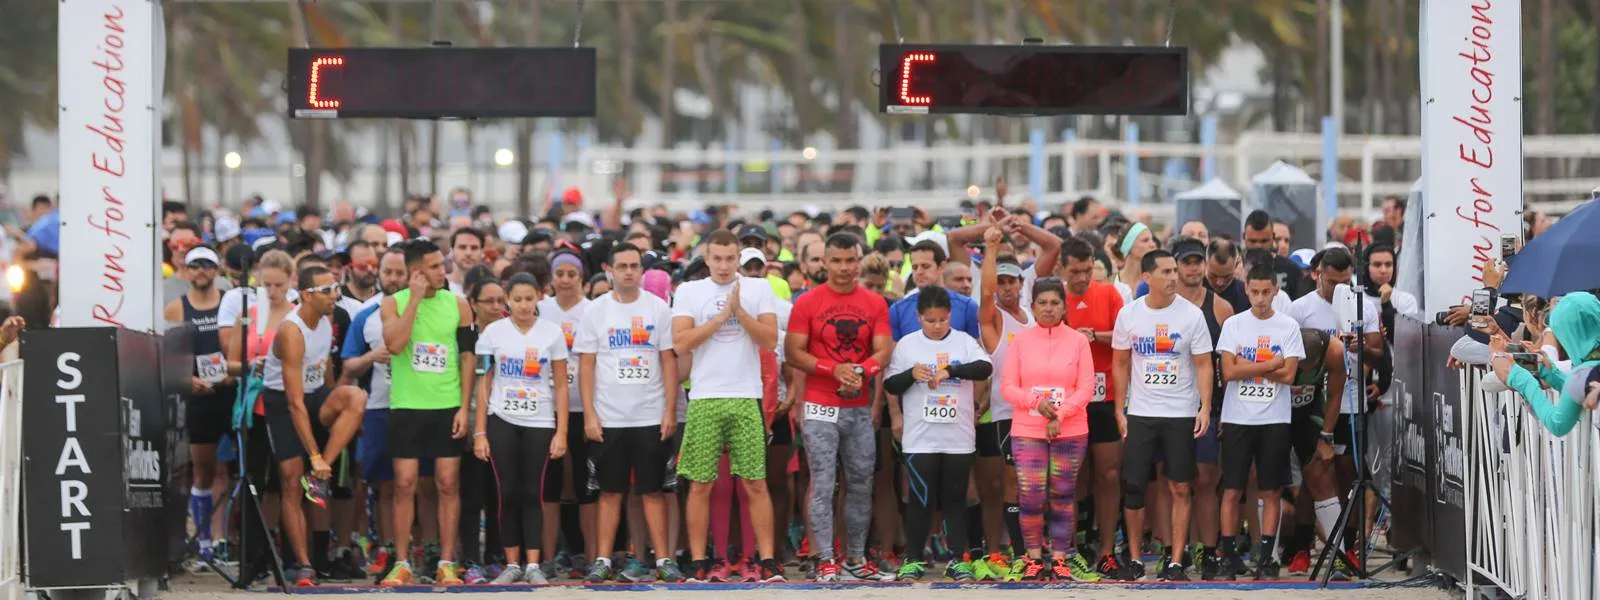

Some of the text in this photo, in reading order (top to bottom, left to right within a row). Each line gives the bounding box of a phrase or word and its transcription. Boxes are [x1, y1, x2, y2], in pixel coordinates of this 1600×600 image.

[1452, 0, 1496, 170] Education
[86, 4, 130, 328] Run for Education
[1456, 177, 1500, 232] for
[608, 335, 632, 347] RUN
[1133, 342, 1156, 354] RUN
[413, 354, 446, 368] 3429
[500, 362, 523, 376] RUN
[618, 368, 650, 379] 3232
[1144, 373, 1177, 385] 2232
[1239, 385, 1274, 398] 2233
[503, 400, 537, 411] 2343
[805, 404, 836, 418] 1399
[923, 406, 957, 418] 1400
[55, 352, 92, 560] START
